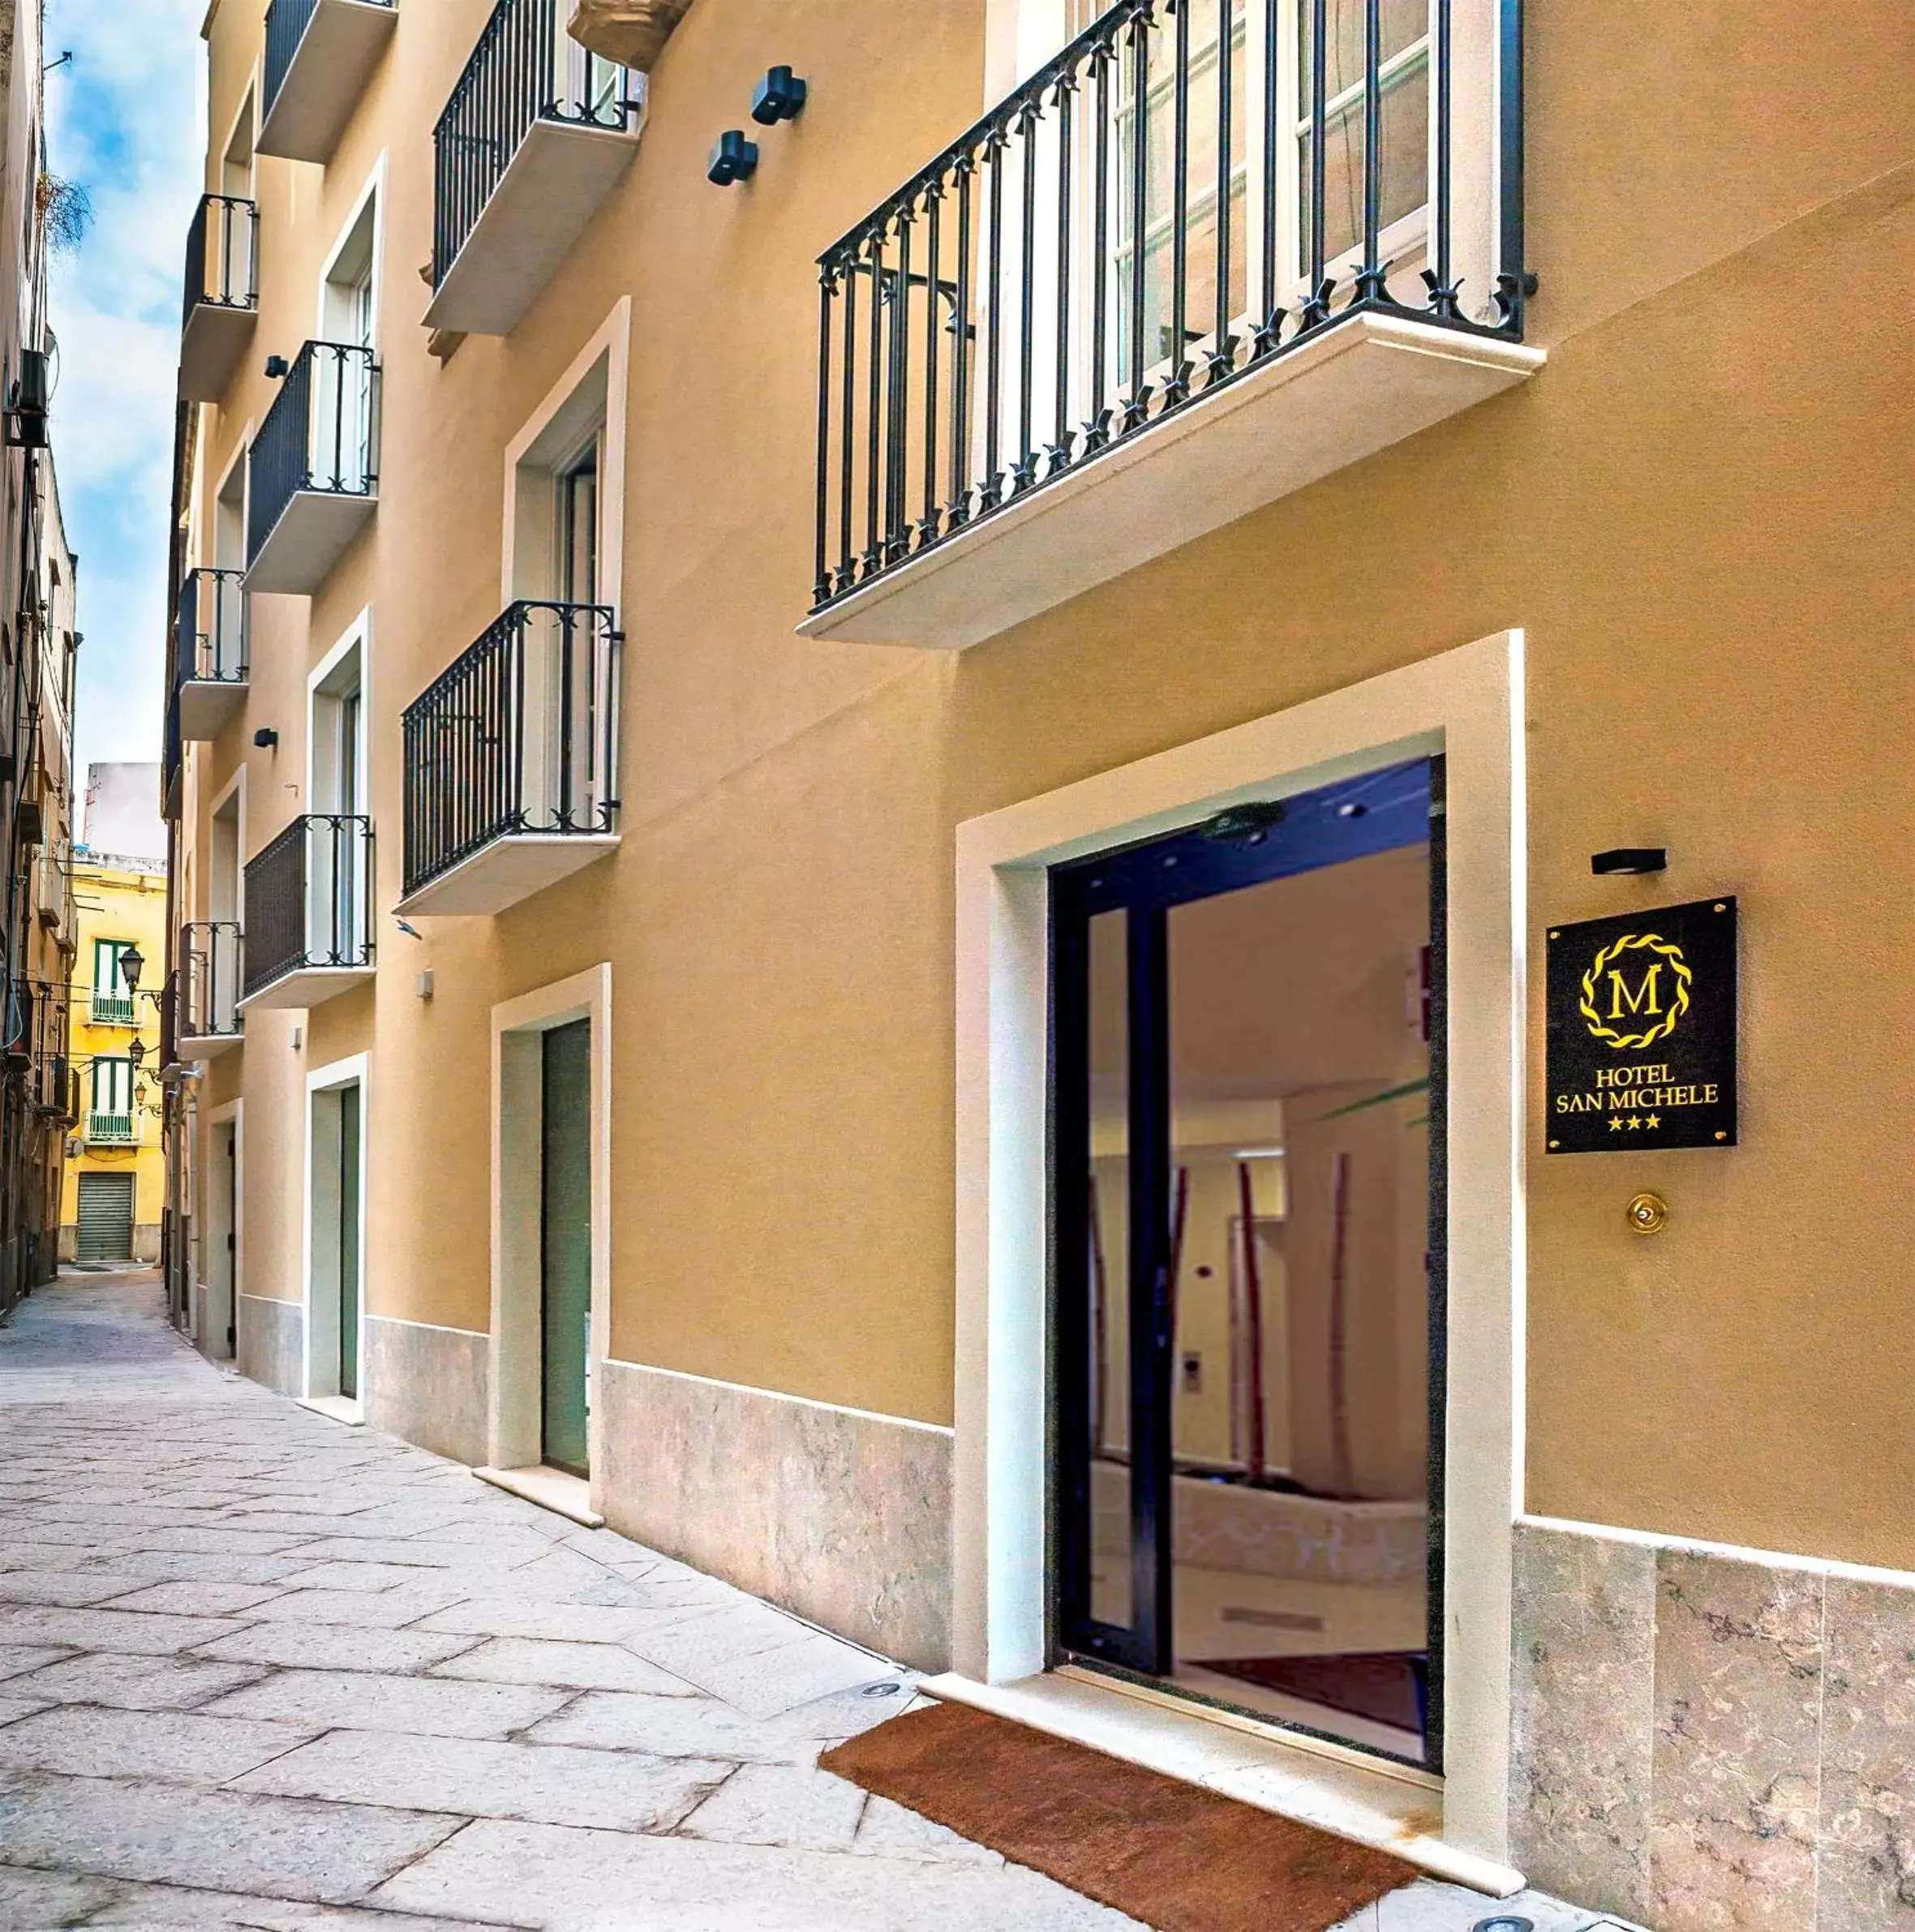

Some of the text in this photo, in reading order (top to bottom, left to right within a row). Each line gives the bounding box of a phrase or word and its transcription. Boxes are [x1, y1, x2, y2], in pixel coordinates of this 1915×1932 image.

[1607, 964, 1663, 1019] M
[1596, 1064, 1675, 1088] HOTEL
[1556, 1084, 1719, 1114] SAN MICHELE
